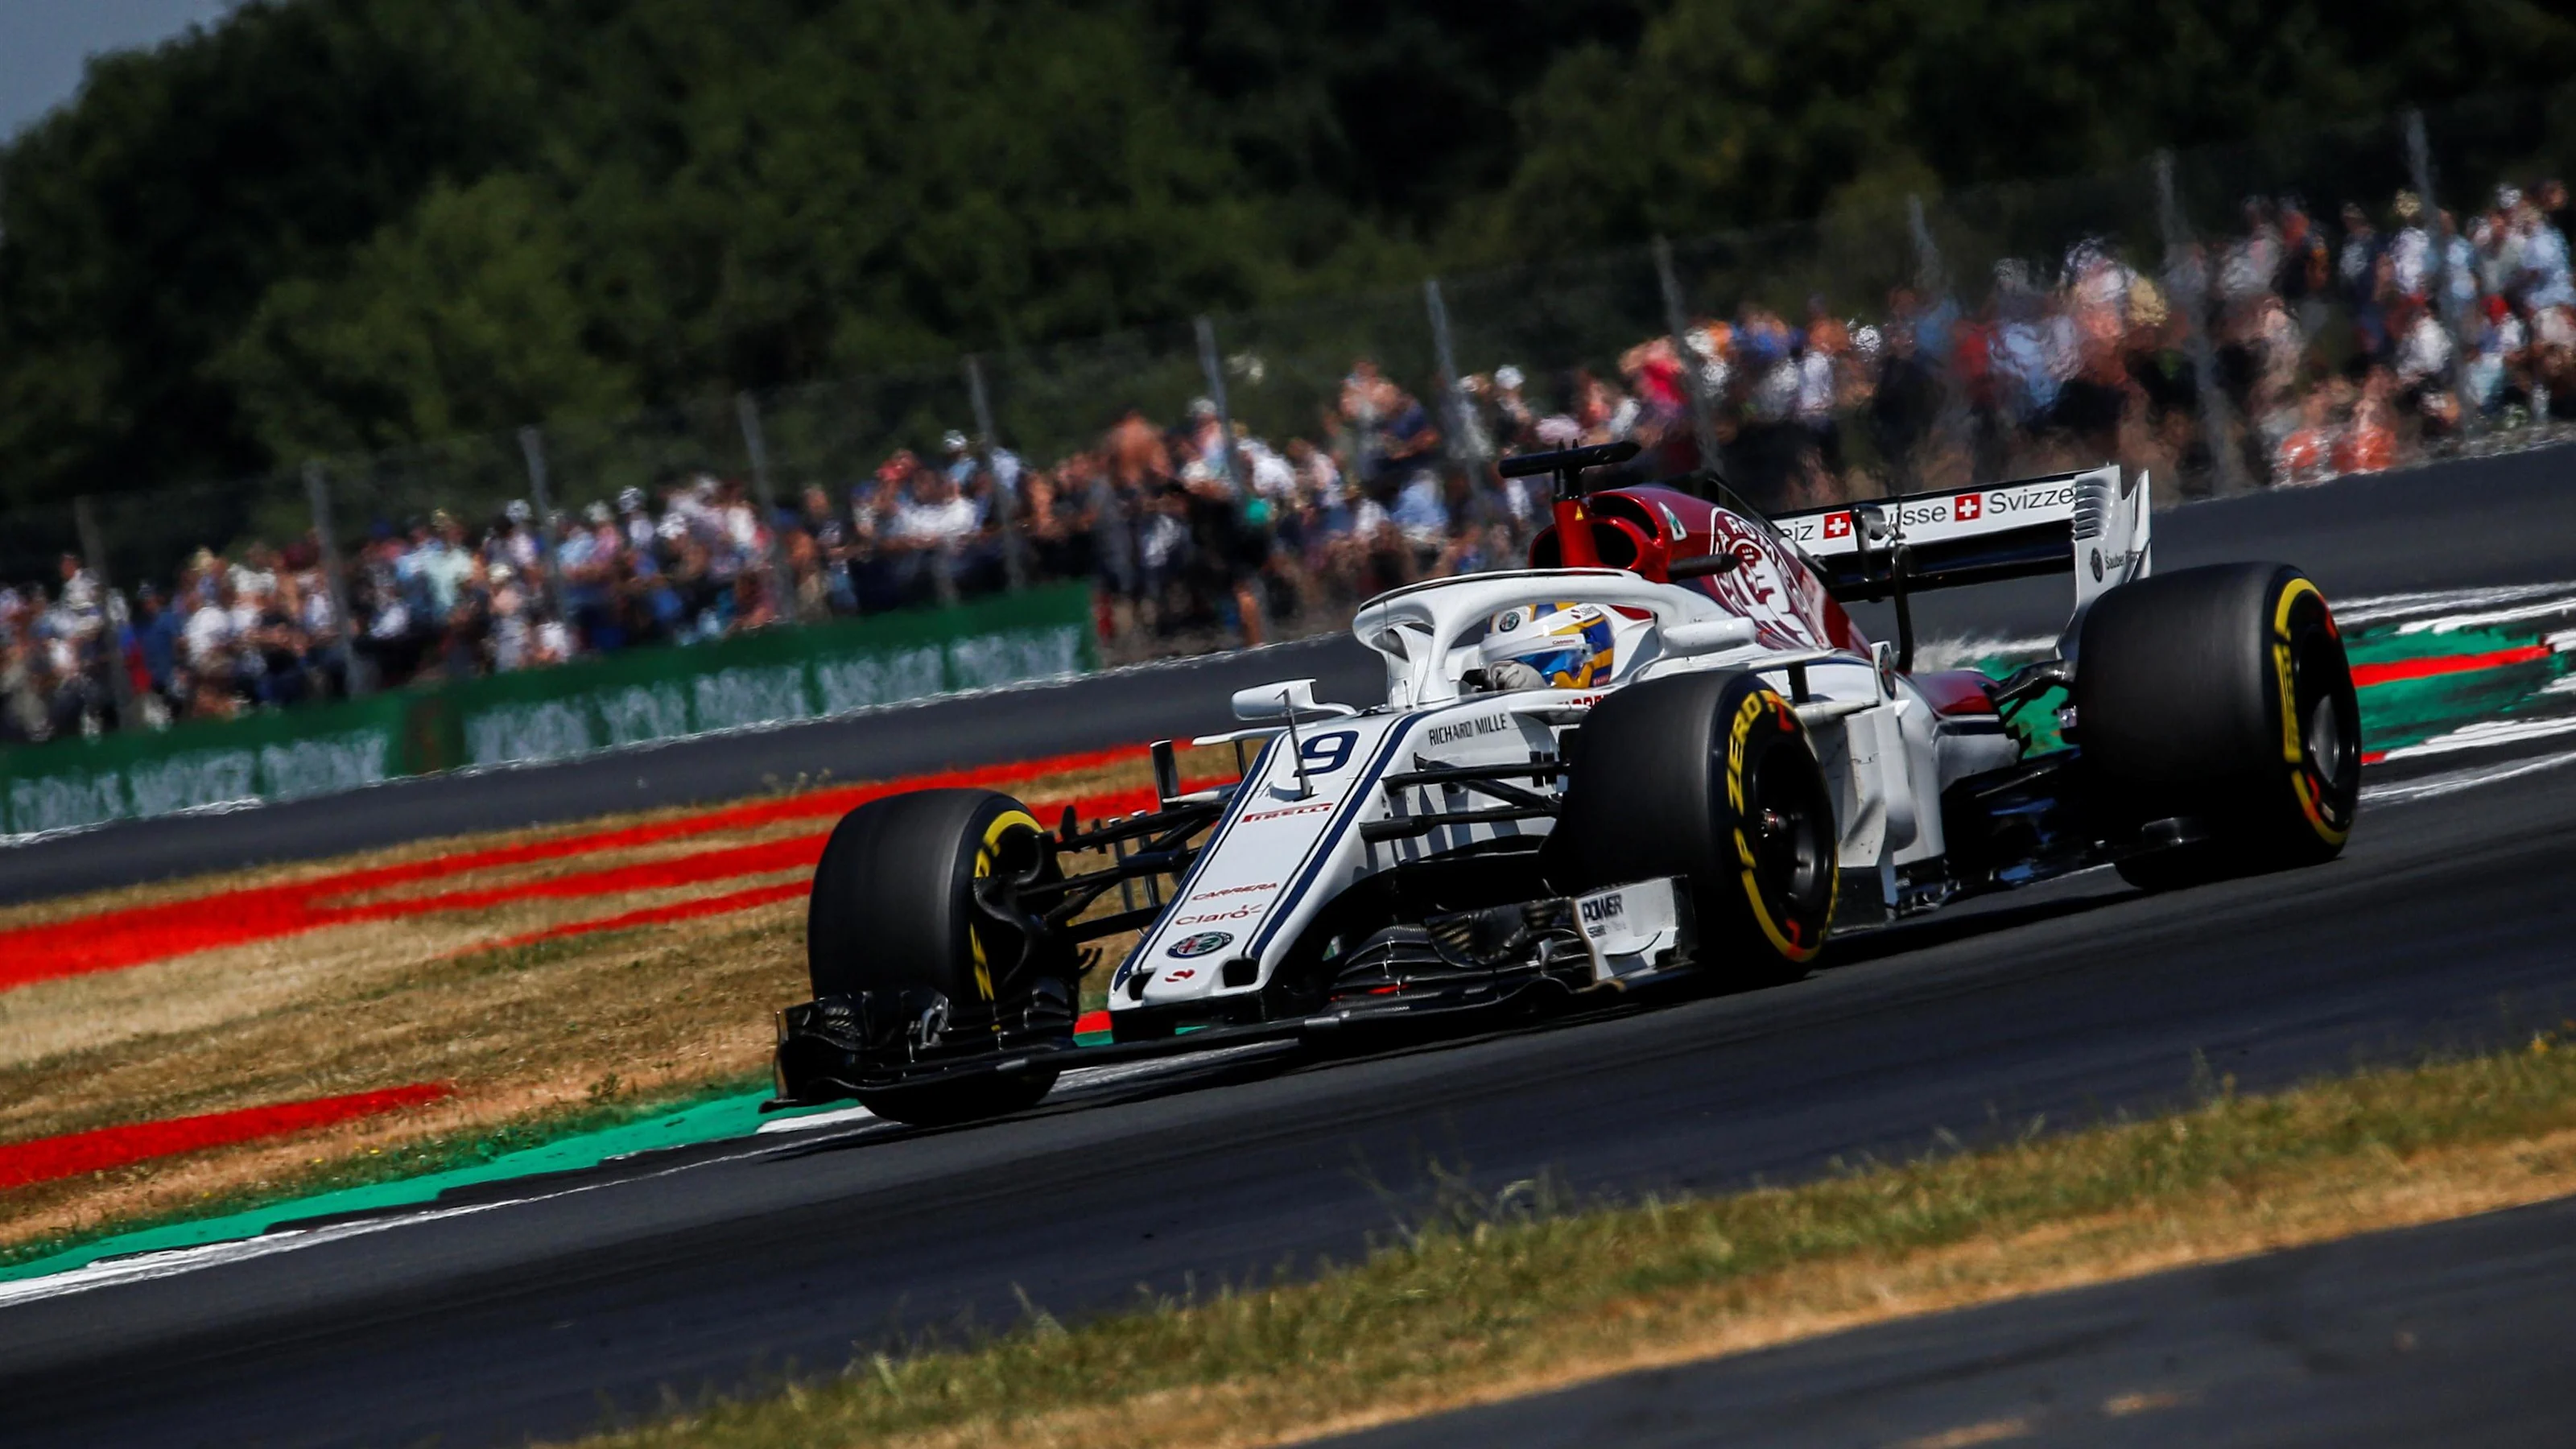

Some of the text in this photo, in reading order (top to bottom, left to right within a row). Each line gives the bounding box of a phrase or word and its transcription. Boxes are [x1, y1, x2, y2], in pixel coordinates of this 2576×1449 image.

[1989, 487, 2074, 514] Svizze
[1428, 713, 1507, 745] RICHARD MILLE
[1292, 730, 1360, 778] 9
[1726, 691, 1762, 817] ZERO
[1241, 803, 1335, 823] PIRELLI
[1192, 882, 1278, 901] CARRERA
[1175, 904, 1251, 926] Claro
[1582, 894, 1624, 923] POWER
